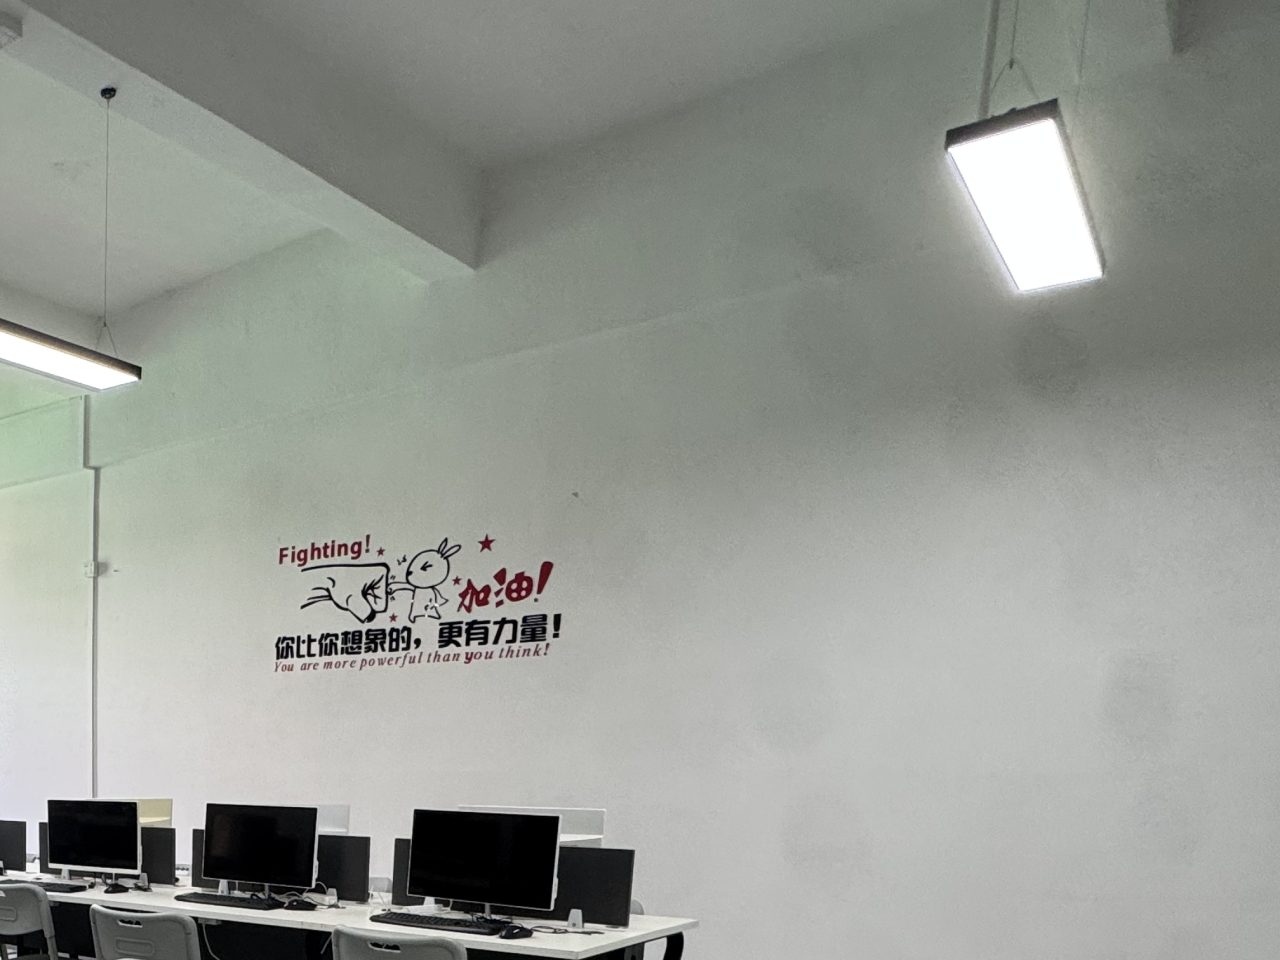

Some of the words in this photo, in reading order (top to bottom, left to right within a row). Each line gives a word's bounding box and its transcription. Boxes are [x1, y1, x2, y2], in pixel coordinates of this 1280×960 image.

[278, 534, 371, 567] Fighting!
[274, 661, 294, 673] You
[300, 662, 319, 671] are
[323, 659, 356, 670] more
[359, 652, 424, 671] powerful
[427, 650, 460, 663] than
[464, 650, 494, 664] you
[499, 643, 550, 659] think!
